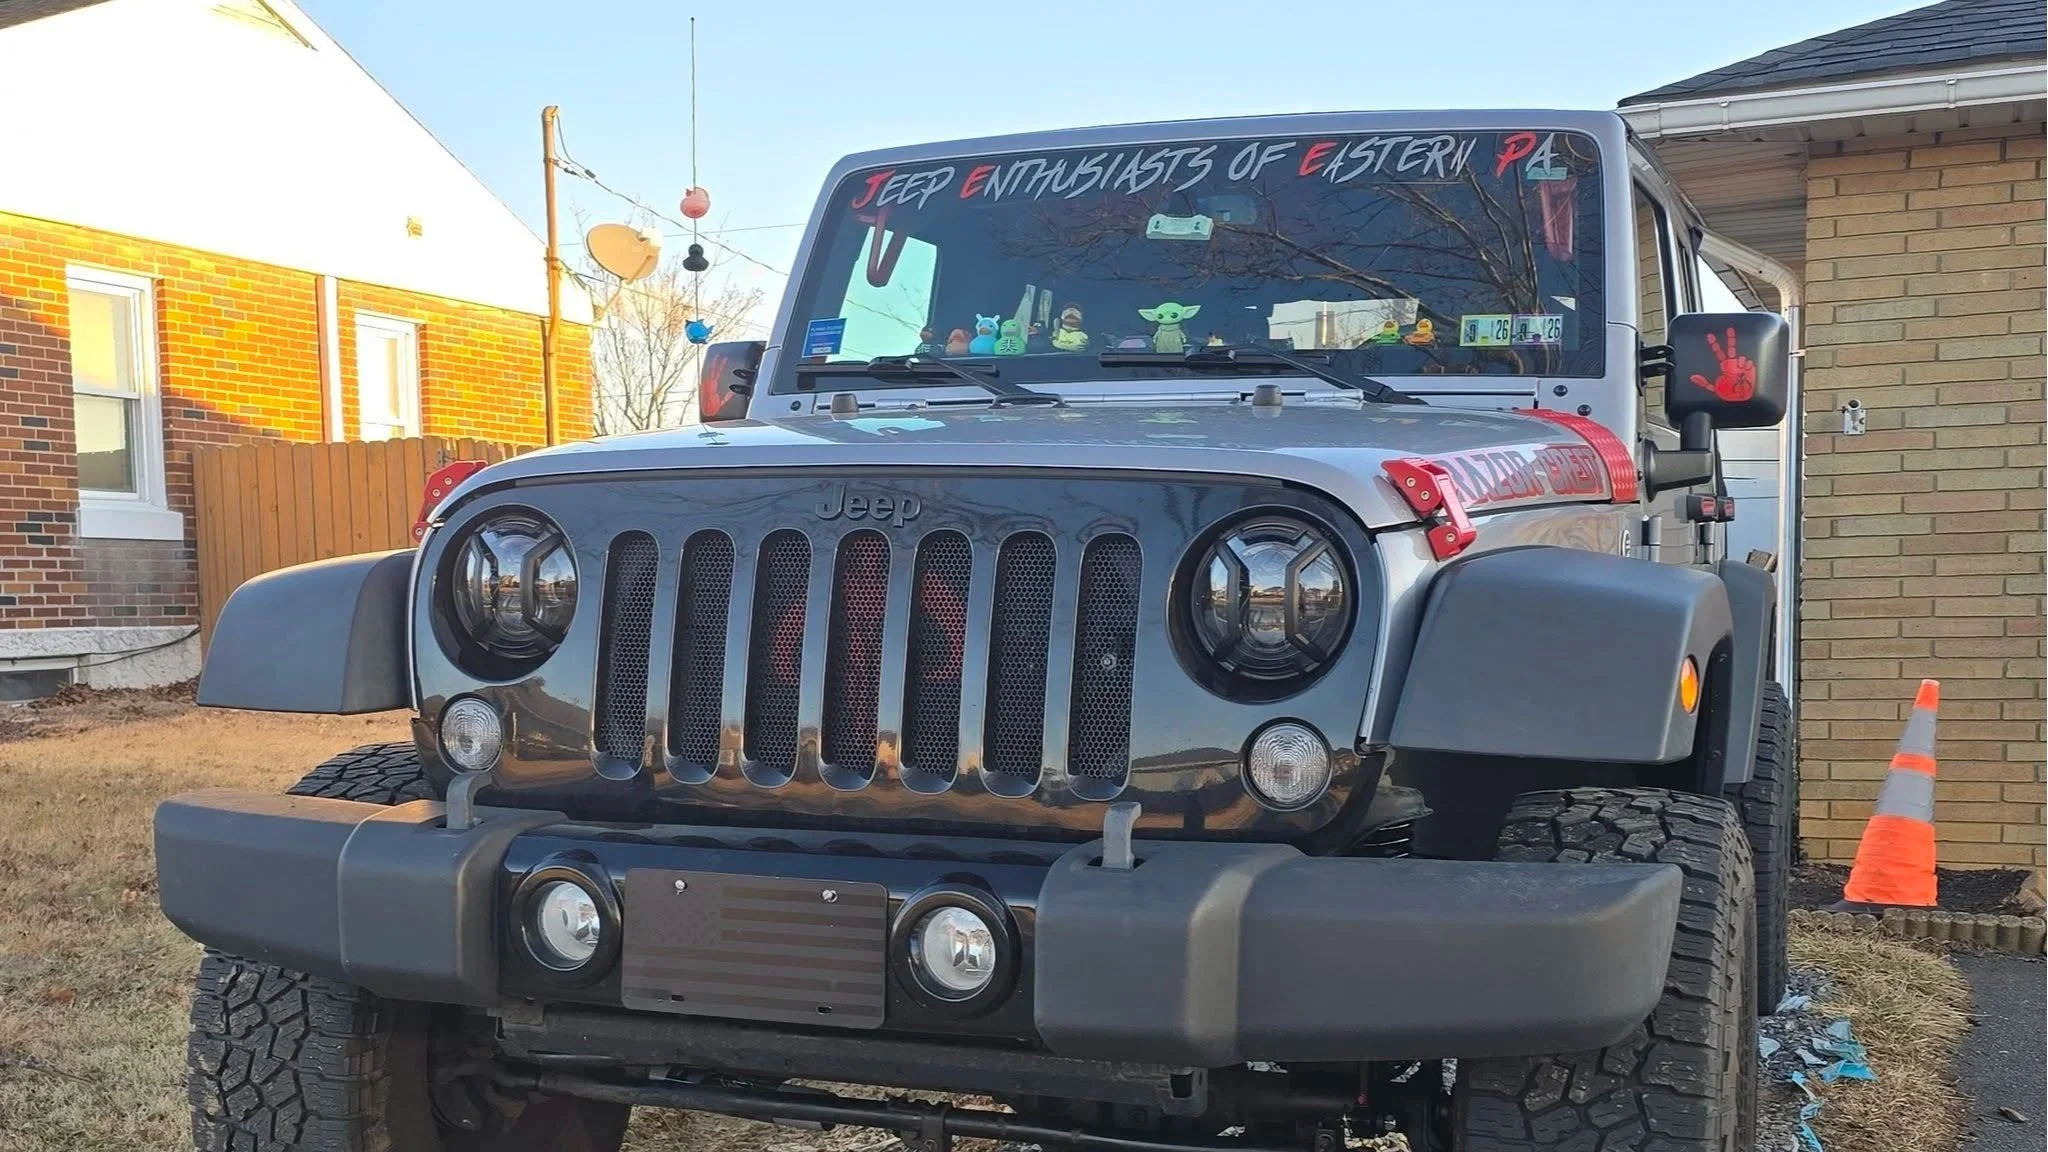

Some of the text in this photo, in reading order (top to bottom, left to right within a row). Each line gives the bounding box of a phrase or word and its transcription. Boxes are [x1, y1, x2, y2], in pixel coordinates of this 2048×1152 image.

[851, 131, 1559, 210] JEEP ENTHUSIASTS OF EASTERN PA
[1495, 319, 1509, 340] 26
[1547, 318, 1560, 338] 26
[815, 483, 921, 528] Jeep
